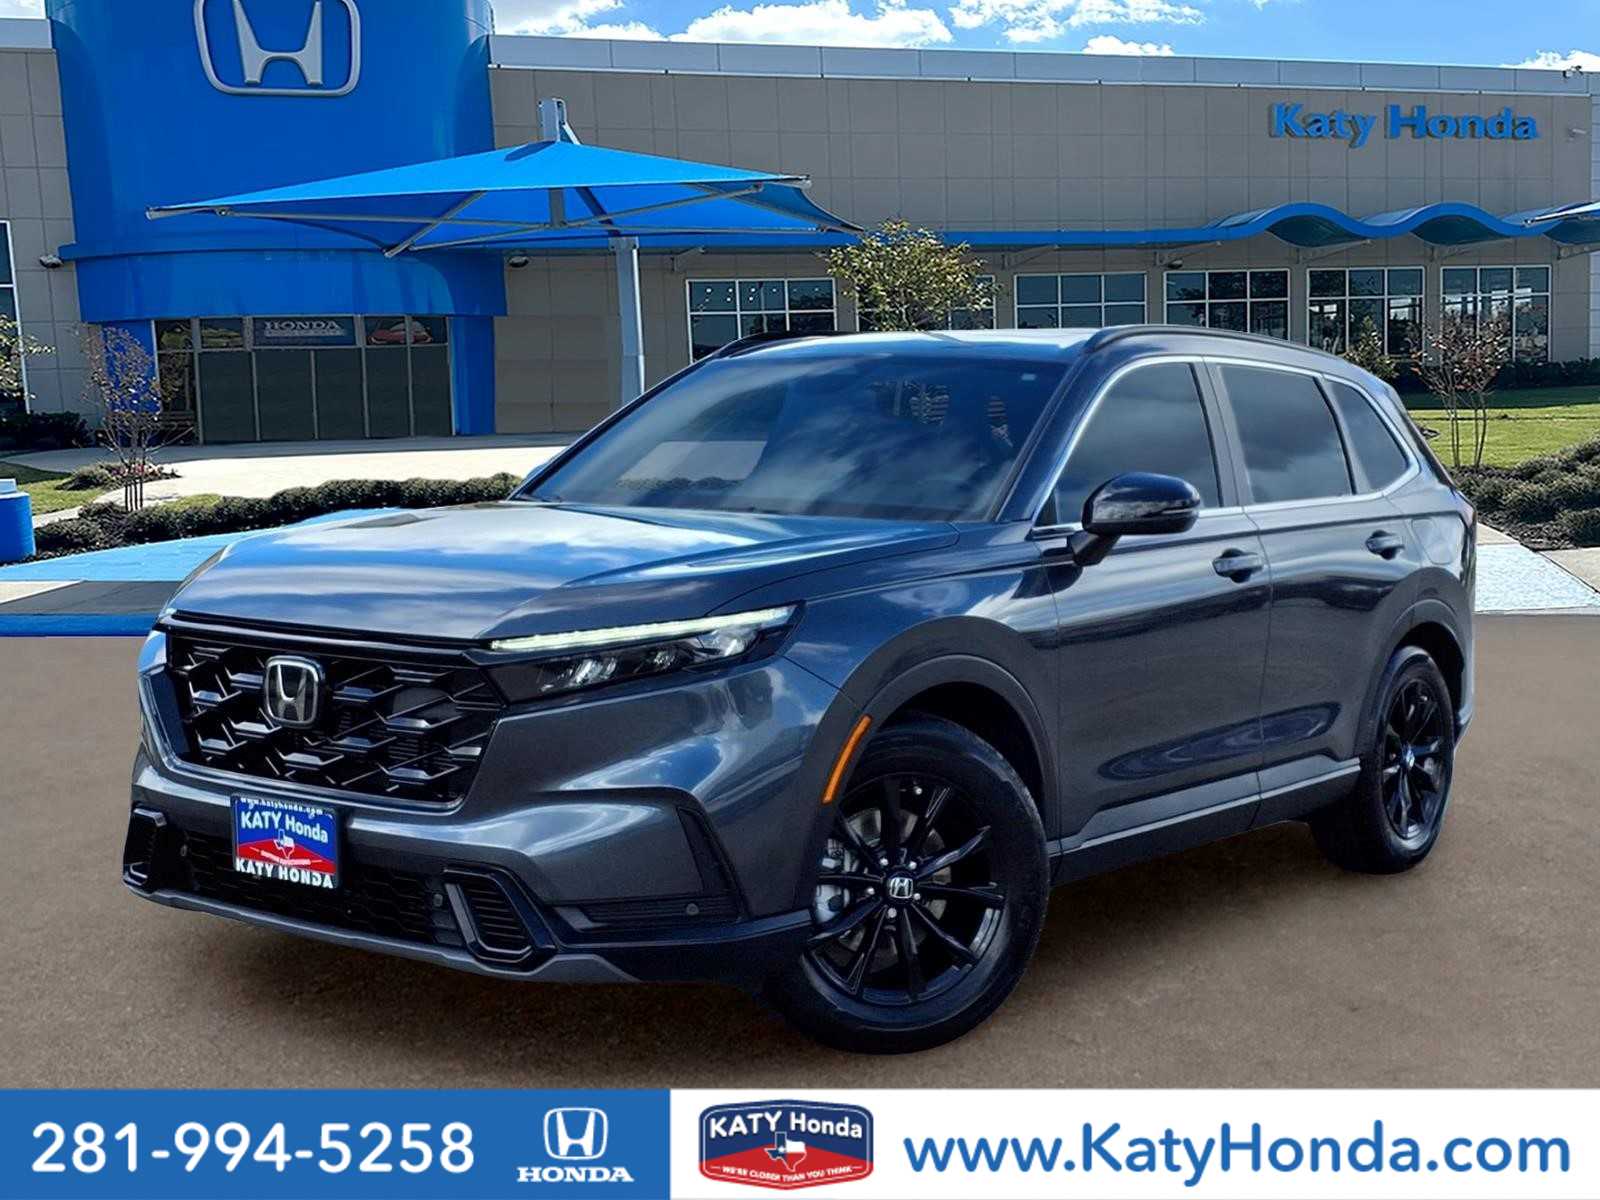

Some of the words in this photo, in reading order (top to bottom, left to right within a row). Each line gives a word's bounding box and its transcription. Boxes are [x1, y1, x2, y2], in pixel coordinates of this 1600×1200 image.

[1269, 102, 1376, 149] Katy
[1384, 104, 1540, 140] Honda
[264, 320, 341, 331] HONDA
[240, 811, 282, 829] KATY
[285, 814, 328, 843] Honda
[236, 857, 274, 878] KATY
[278, 867, 334, 889] HONDA
